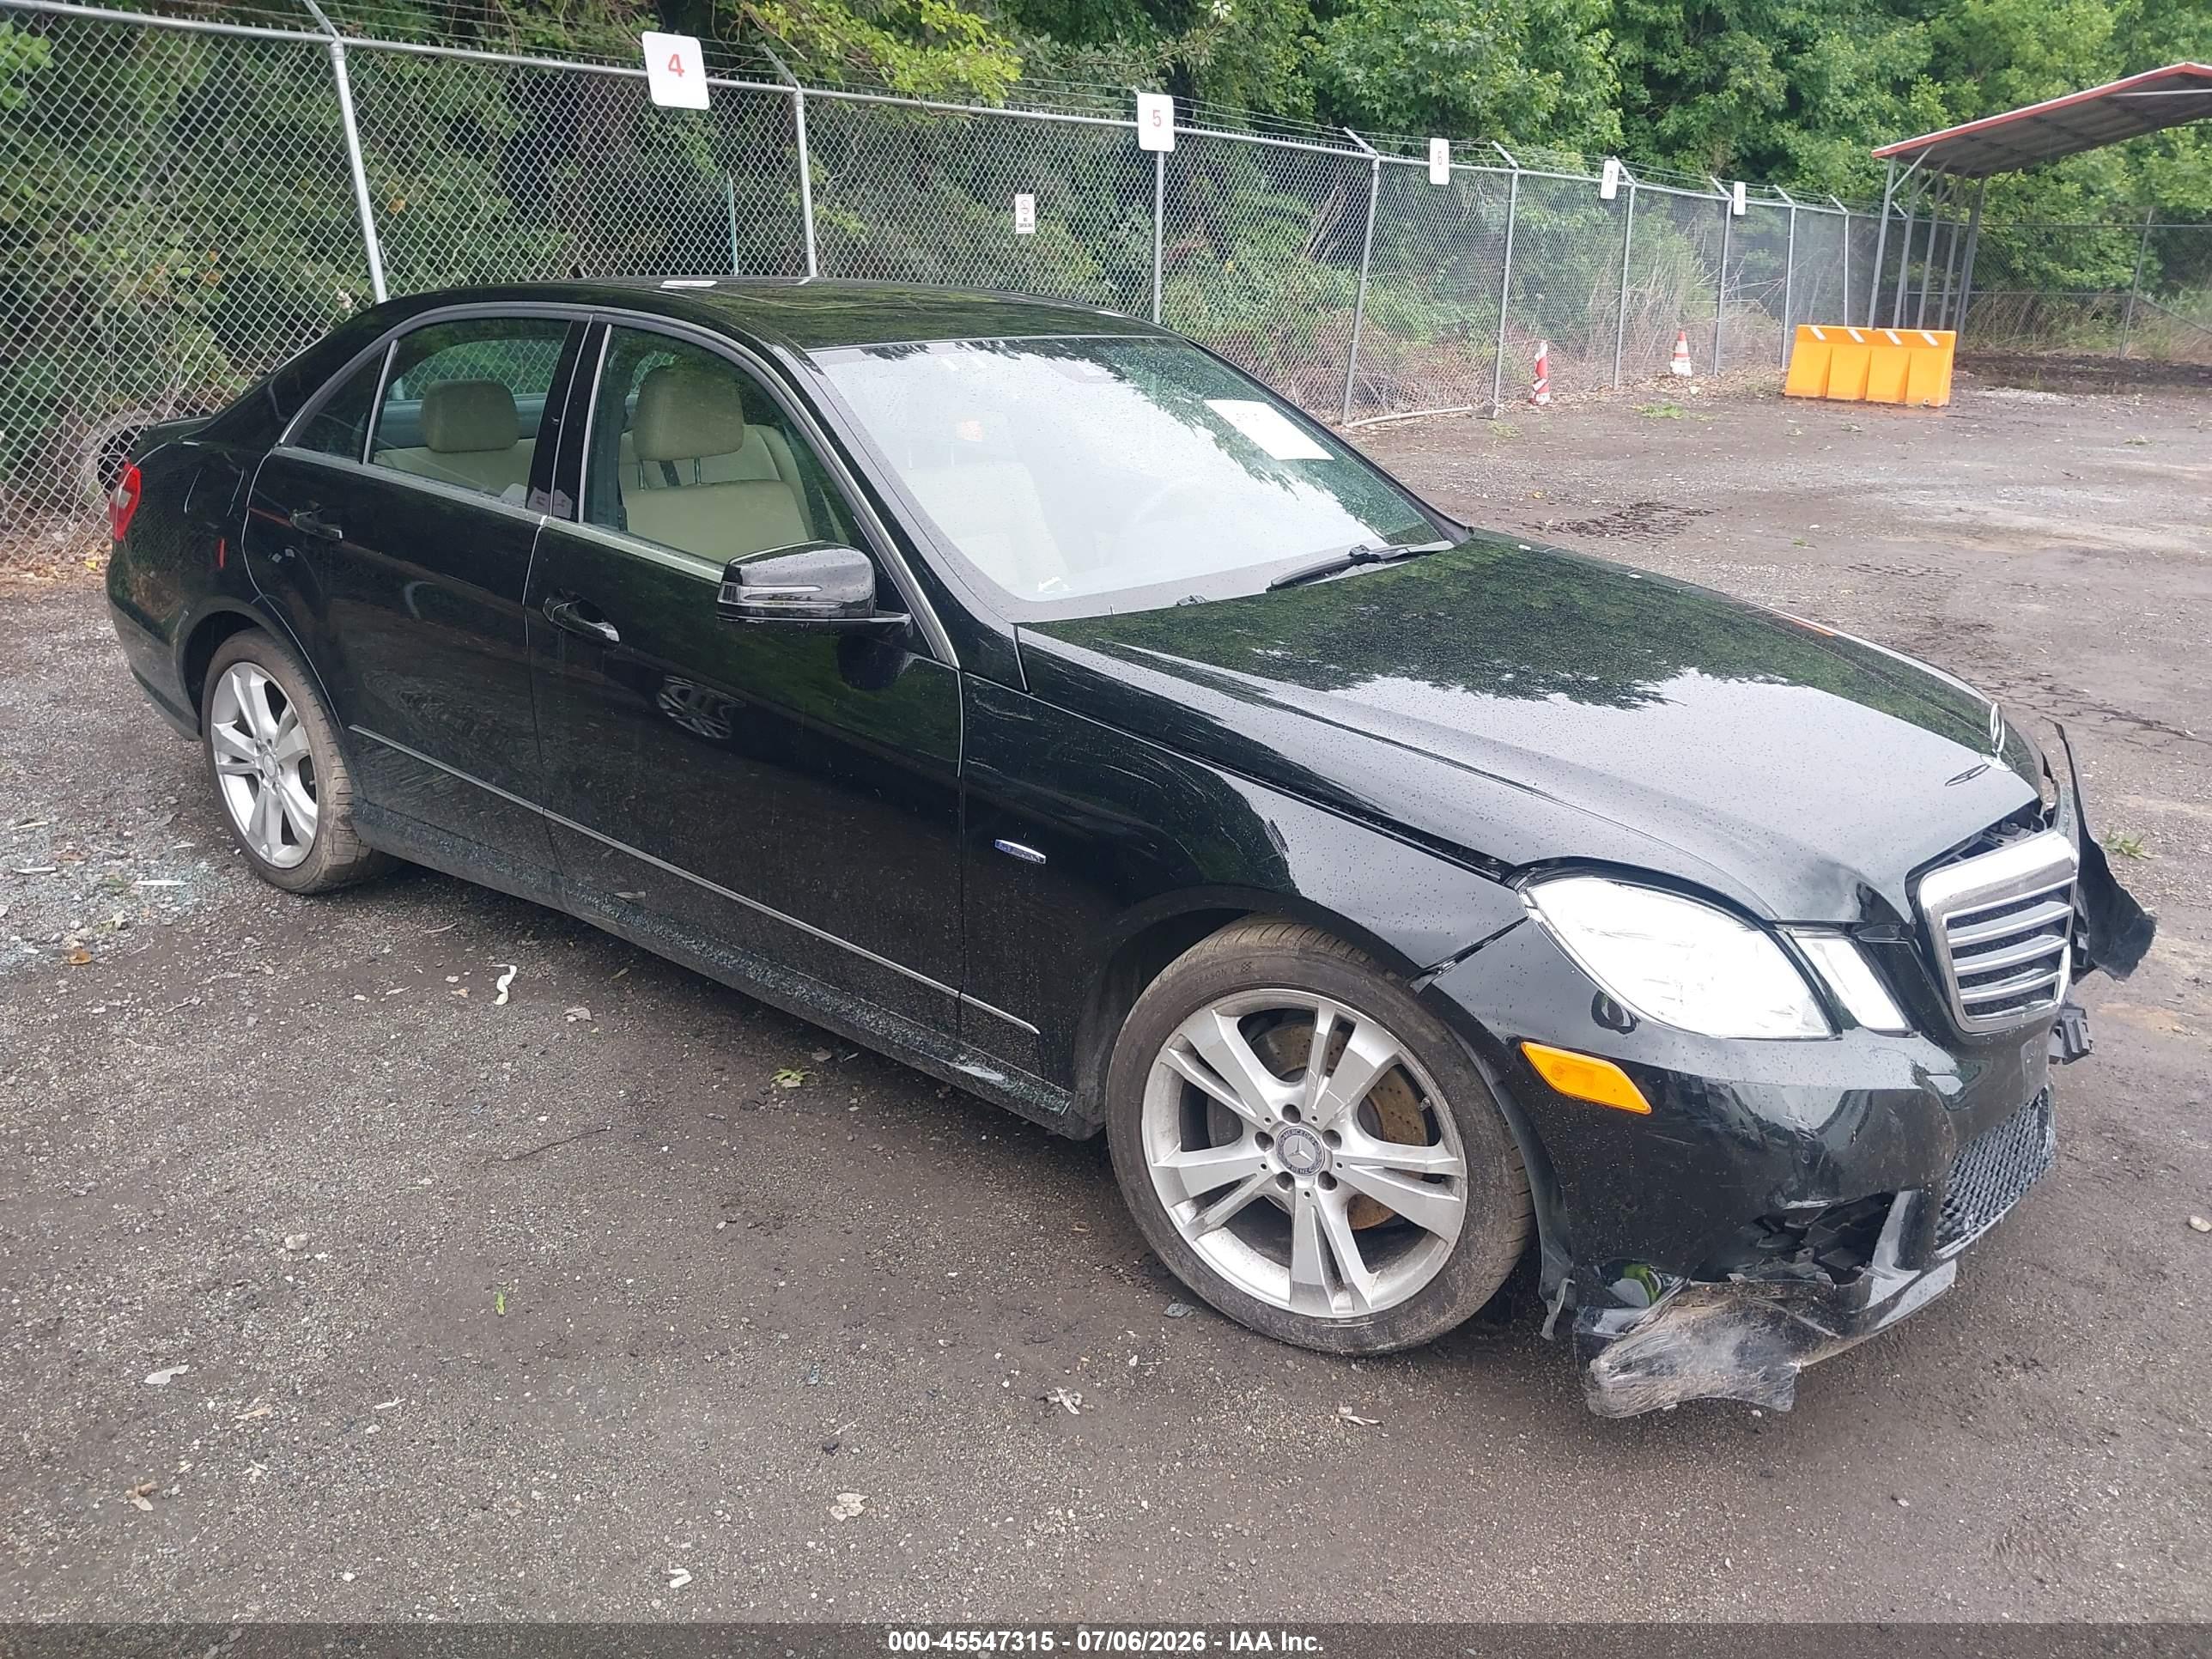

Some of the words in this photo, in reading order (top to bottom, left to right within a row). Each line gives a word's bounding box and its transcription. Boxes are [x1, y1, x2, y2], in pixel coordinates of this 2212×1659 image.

[668, 53, 685, 77] 4
[1152, 109, 1162, 127] 5
[1437, 150, 1443, 166] 6
[1283, 1129, 1316, 1144] MERCEDES
